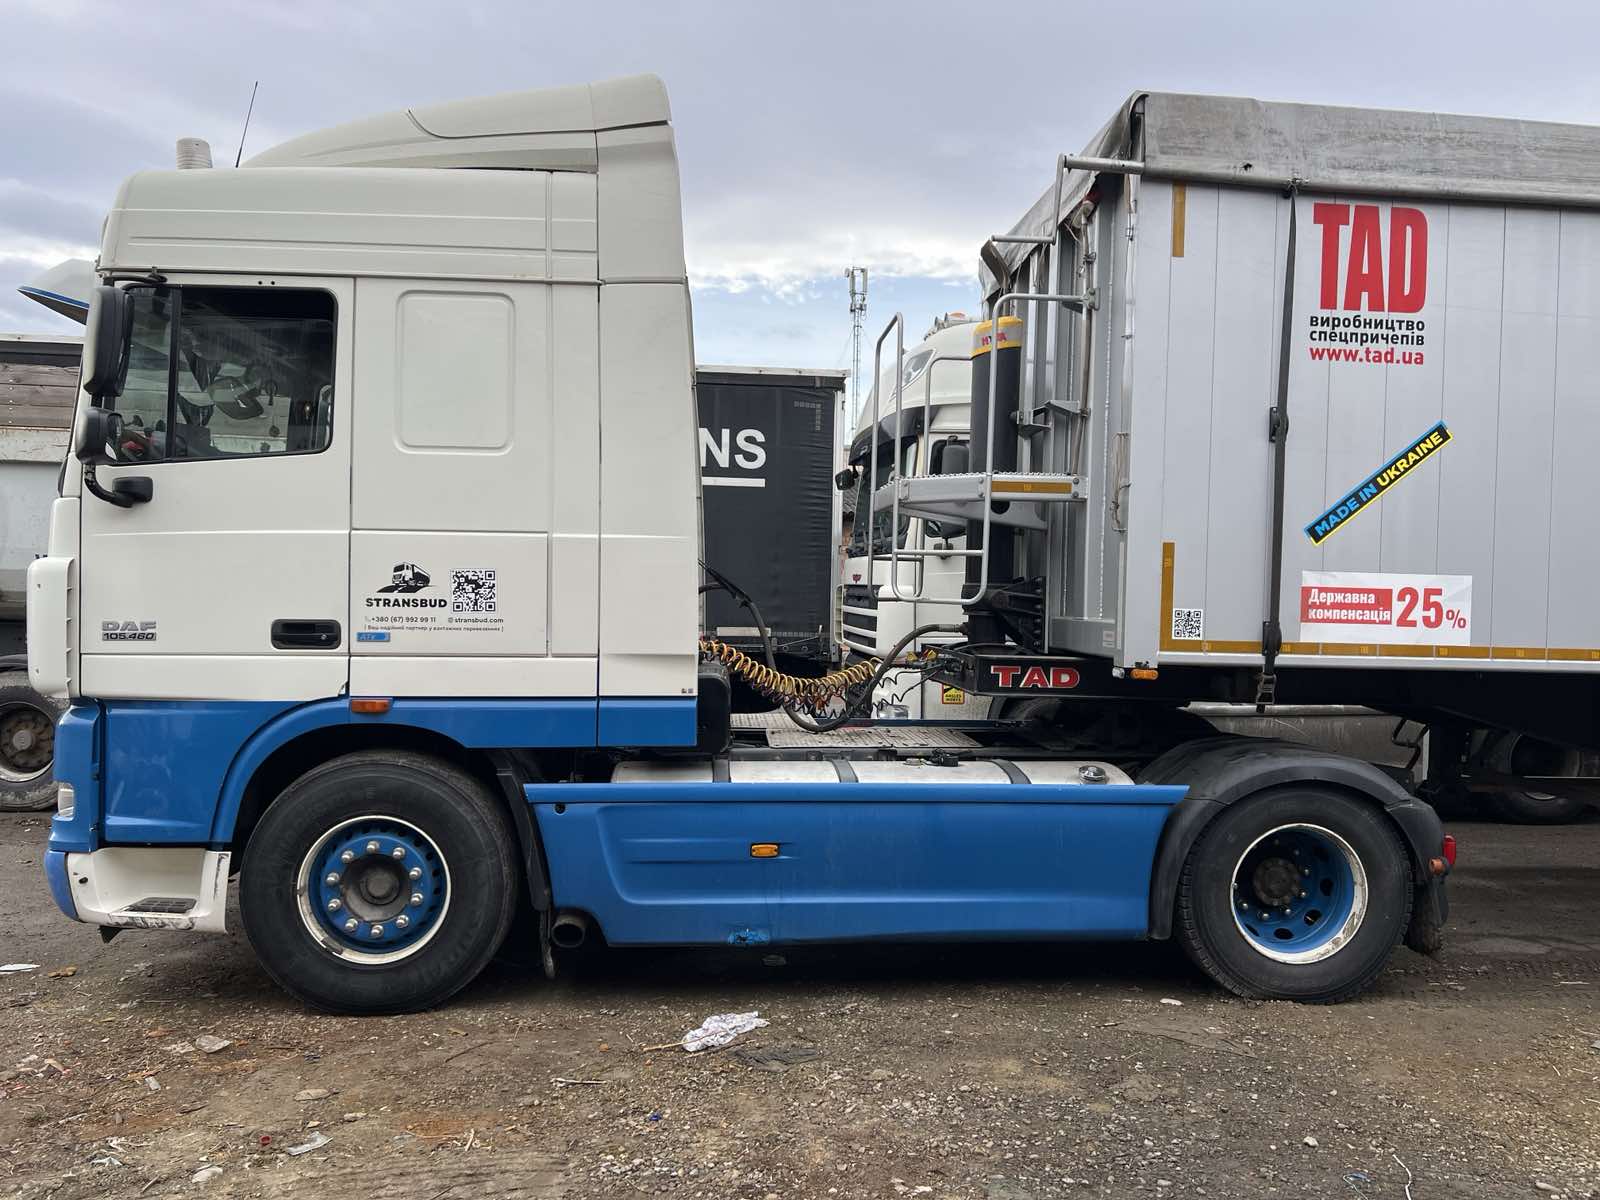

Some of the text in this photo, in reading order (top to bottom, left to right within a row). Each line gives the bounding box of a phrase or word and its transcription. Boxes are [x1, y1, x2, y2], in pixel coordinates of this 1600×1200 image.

[1313, 203, 1428, 314] TAD
[1309, 315, 1425, 332] виробництво
[1309, 329, 1425, 346] спецпричепів
[1309, 347, 1424, 365] www.tad.ua
[1314, 431, 1444, 537] MADE IN UKRAINE
[365, 598, 448, 608] STRANSBUD
[1308, 588, 1376, 605] Державна
[1308, 607, 1392, 623] компенсація
[1396, 586, 1467, 629] 25%
[102, 621, 156, 631] DAF
[390, 616, 404, 624] (67)
[990, 665, 1080, 689] TAD
